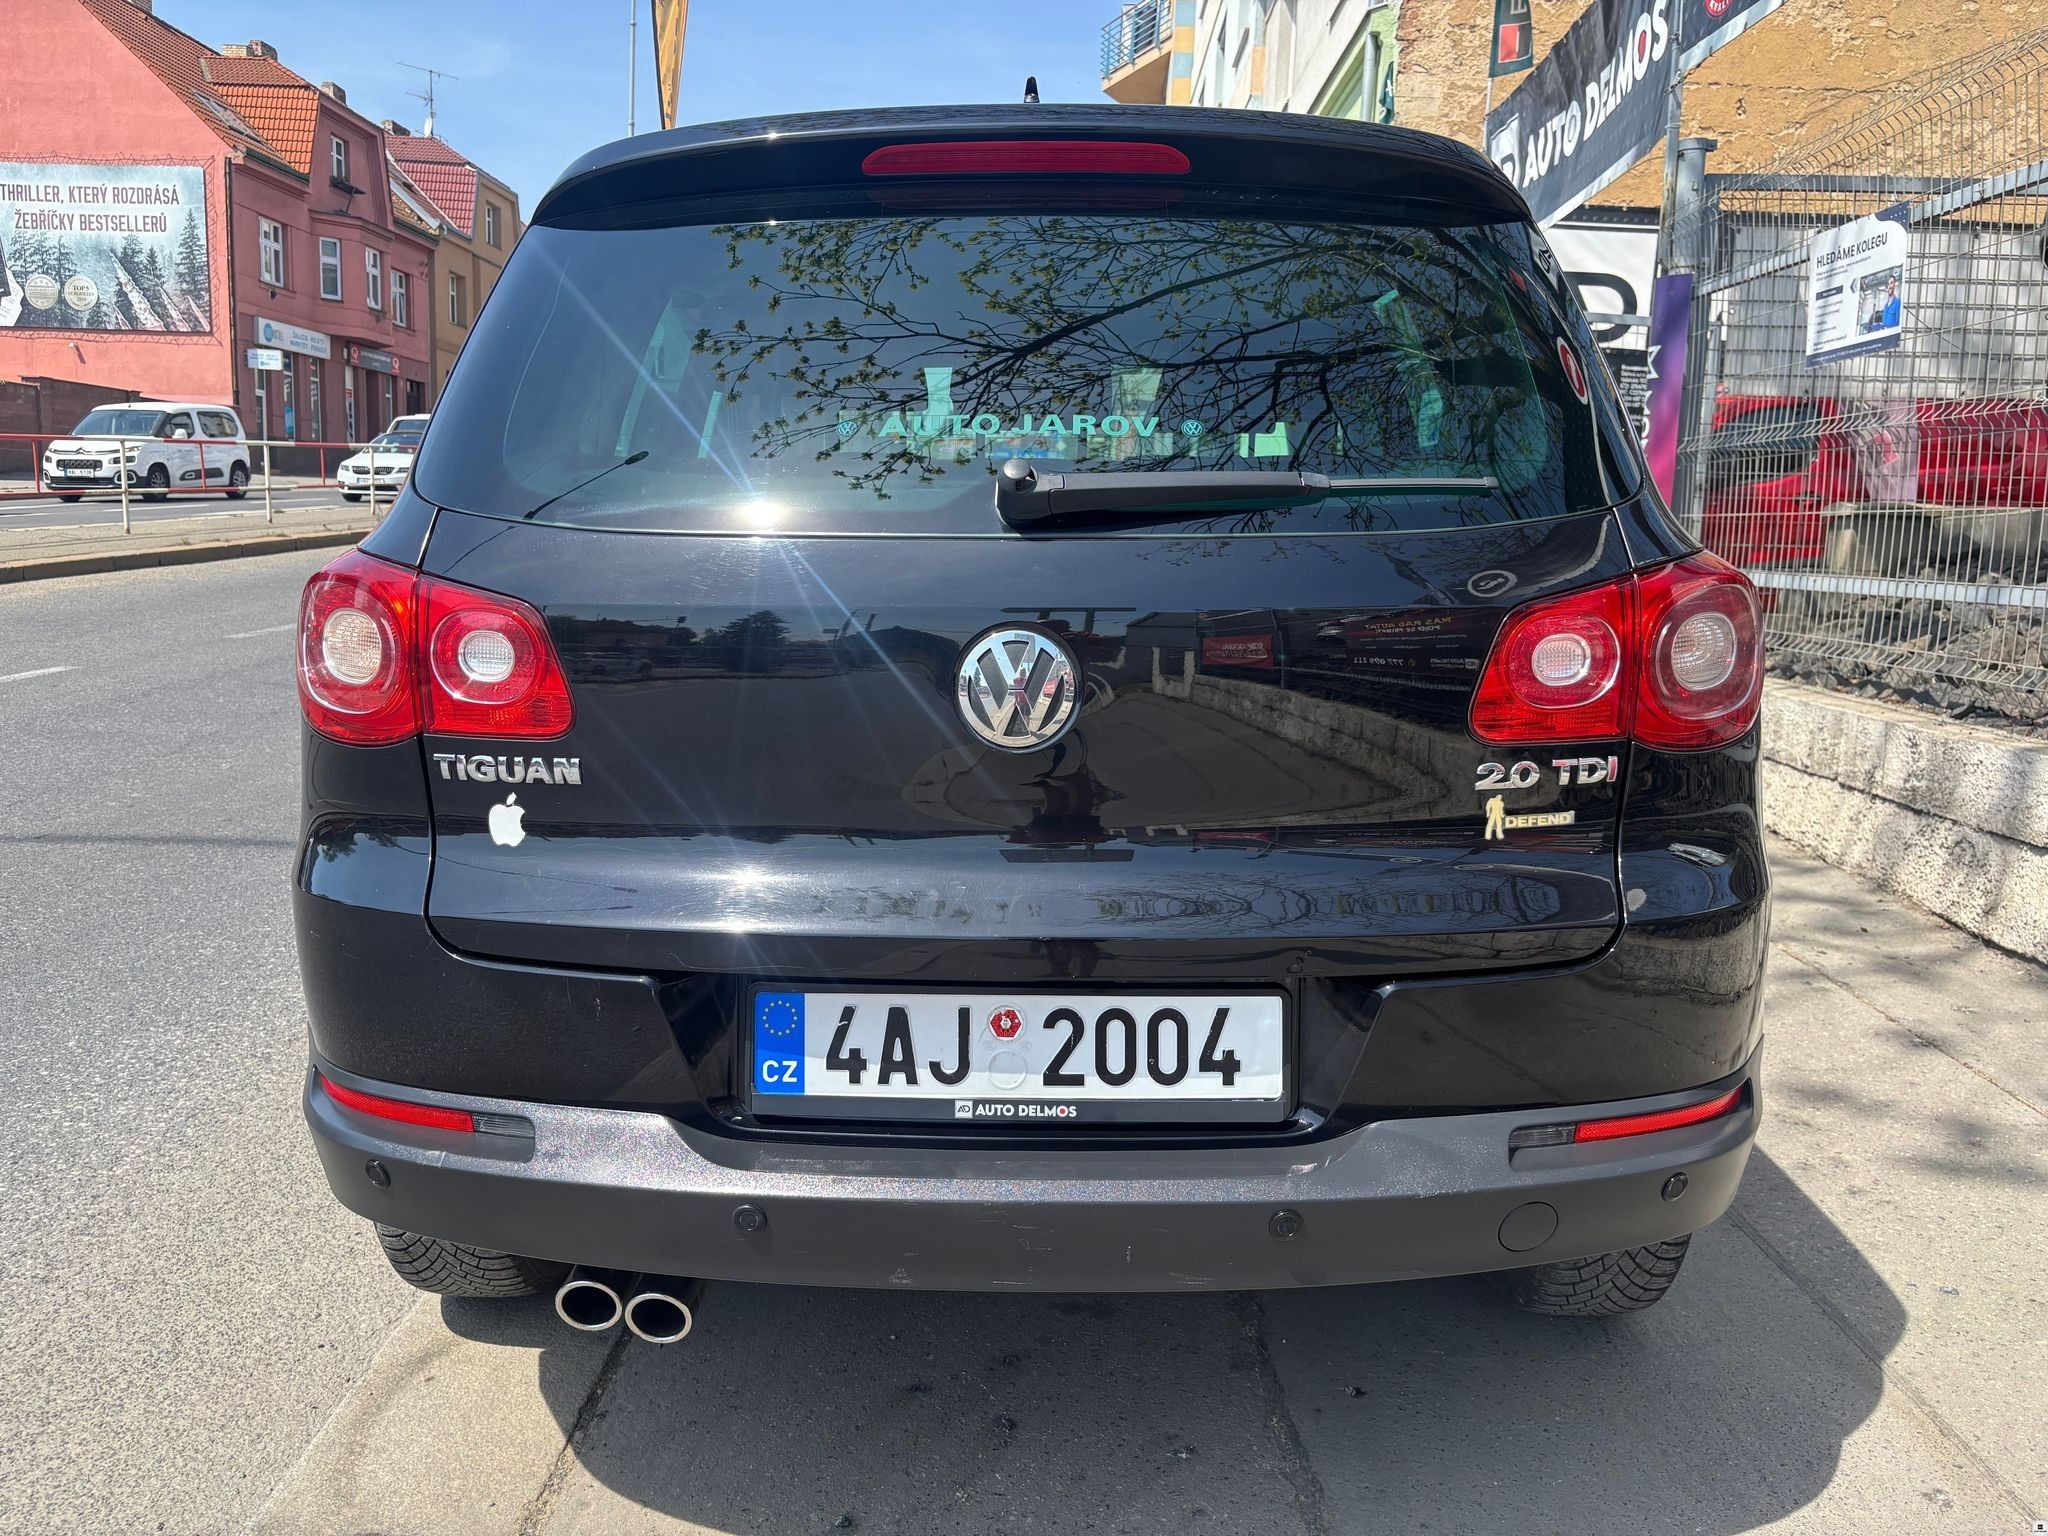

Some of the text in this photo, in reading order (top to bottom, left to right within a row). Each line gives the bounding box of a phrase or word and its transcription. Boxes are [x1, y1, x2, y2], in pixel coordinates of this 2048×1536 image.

[1522, 0, 1669, 188] AUTO DELMOS
[0, 183, 180, 206] THRILLER, KTERÝ ROZDRÁSÁ
[14, 208, 168, 233] ŽEBŘÍČKY BESTSELLERŮ
[1816, 244, 1856, 269] HLEDÁME
[1856, 231, 1888, 256] KOLEGU
[878, 414, 1001, 438] AUTO
[1011, 414, 1160, 438] JAROV
[433, 753, 582, 785] TIGUAN
[1552, 755, 1618, 786] TDI
[1505, 812, 1573, 828] DEFEND
[824, 1005, 1242, 1087] 4AJ 2004
[762, 1060, 798, 1083] CZ
[975, 1103, 1015, 1117] AUTO
[1018, 1104, 1077, 1118] DELMOS
